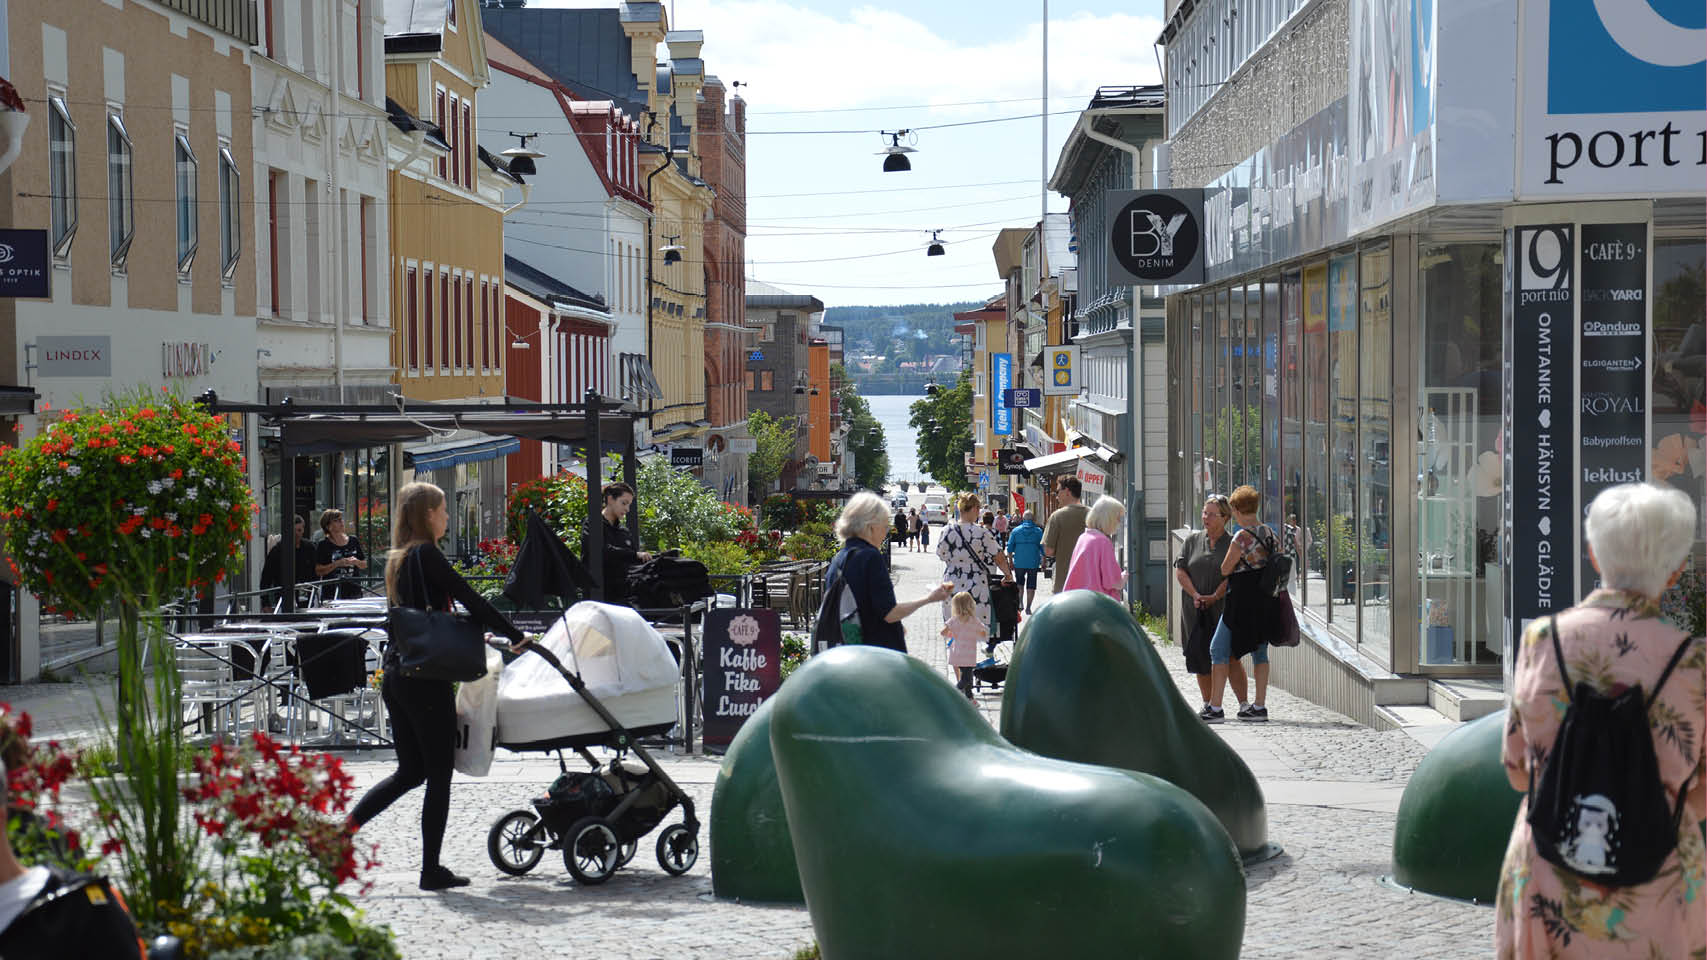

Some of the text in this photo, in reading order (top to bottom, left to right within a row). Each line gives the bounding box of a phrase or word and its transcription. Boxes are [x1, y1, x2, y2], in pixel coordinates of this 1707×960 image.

[1544, 121, 1681, 184] port
[1131, 209, 1188, 257] BY
[1627, 243, 1635, 260] 9
[9, 268, 41, 276] OPTIK
[1138, 258, 1175, 268] DENIM
[1521, 289, 1569, 305] port nio
[46, 350, 102, 361] LINDEX
[1538, 313, 1552, 404] OMTANKE
[1582, 397, 1644, 416] ROYAL
[997, 409, 1009, 431] Kjell
[1583, 436, 1642, 447] Babyproffsen
[1538, 434, 1554, 510] HÄNSYN
[1584, 467, 1642, 482] leklust
[1538, 541, 1554, 608] GLÄDJE
[720, 647, 767, 671] Kaffe
[724, 672, 761, 692] Fika
[716, 695, 763, 716] Lunc
